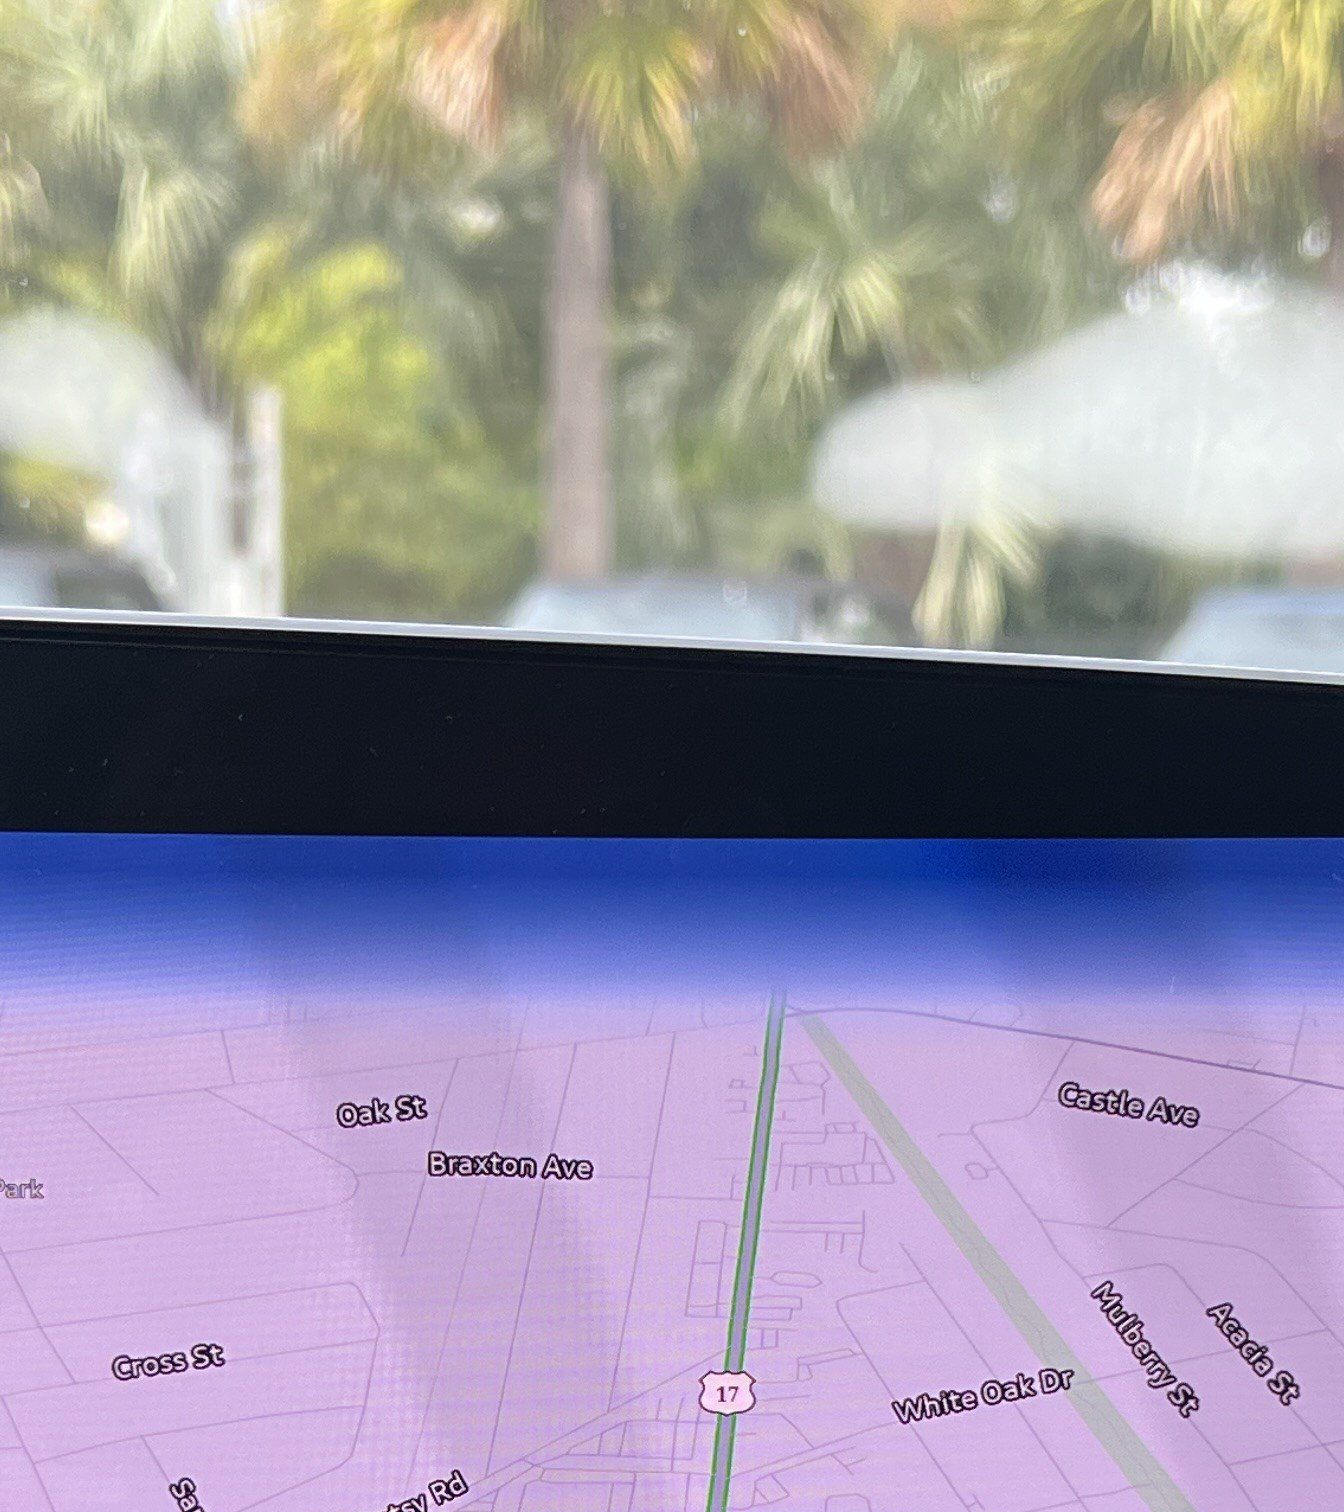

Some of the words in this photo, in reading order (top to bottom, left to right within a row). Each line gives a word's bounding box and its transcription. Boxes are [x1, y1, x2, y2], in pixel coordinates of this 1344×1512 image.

[336, 1098, 390, 1127] Oak
[394, 1094, 427, 1121] St
[1057, 1082, 1143, 1120] Castle
[1147, 1097, 1199, 1129] Ave
[428, 1150, 537, 1179] Braxton
[541, 1154, 594, 1180] Ave
[111, 1350, 187, 1381] Cross
[190, 1343, 225, 1370] St
[1090, 1280, 1176, 1391] Mulberry
[1166, 1385, 1199, 1418] St
[1206, 1302, 1275, 1379] Acacia
[1267, 1369, 1301, 1406] St
[716, 1386, 739, 1403] 17
[892, 1387, 977, 1425] White
[981, 1375, 1035, 1404] Oak
[1038, 1368, 1075, 1394] Dr
[428, 1470, 469, 1506] Rd
